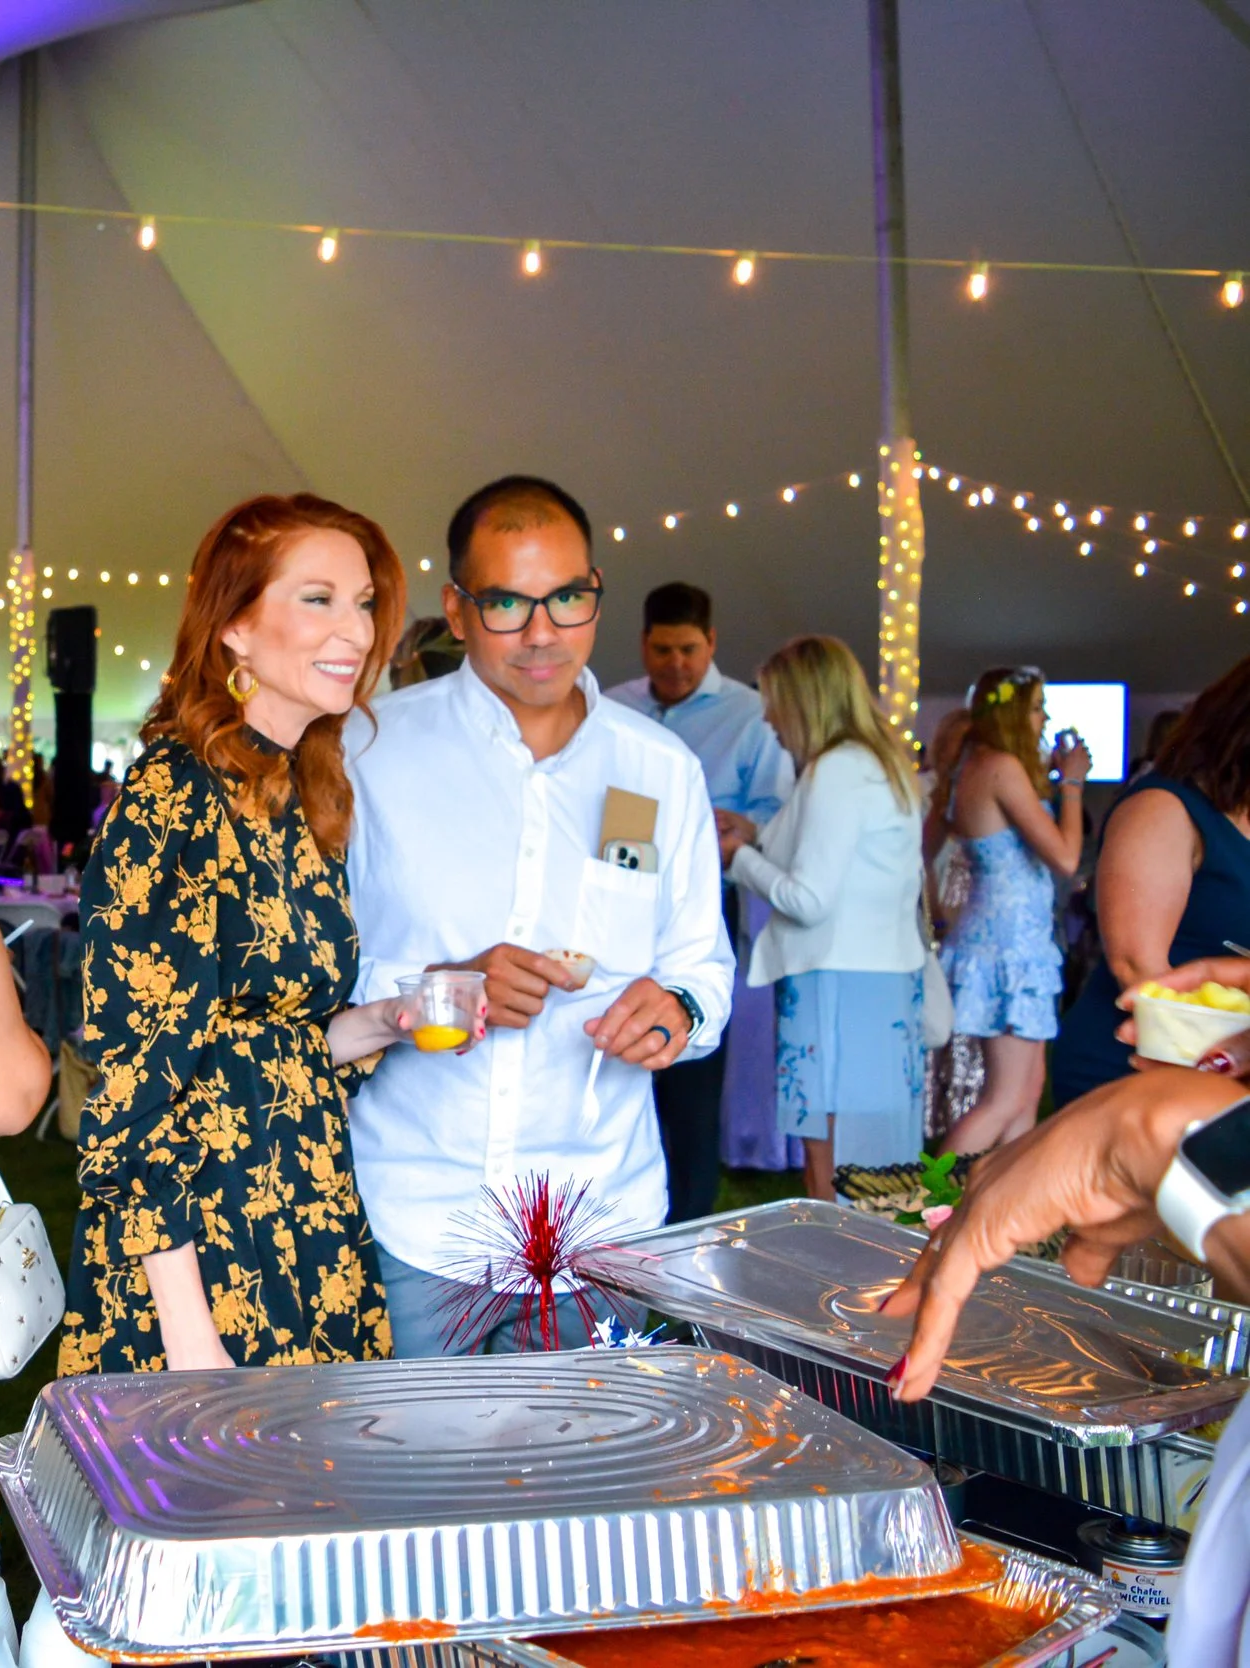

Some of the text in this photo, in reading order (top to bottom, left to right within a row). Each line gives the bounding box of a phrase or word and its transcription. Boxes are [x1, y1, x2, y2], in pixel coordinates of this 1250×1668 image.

[1130, 1586, 1162, 1596] Chafer
[1119, 1592, 1171, 1605] WICK FUEL
